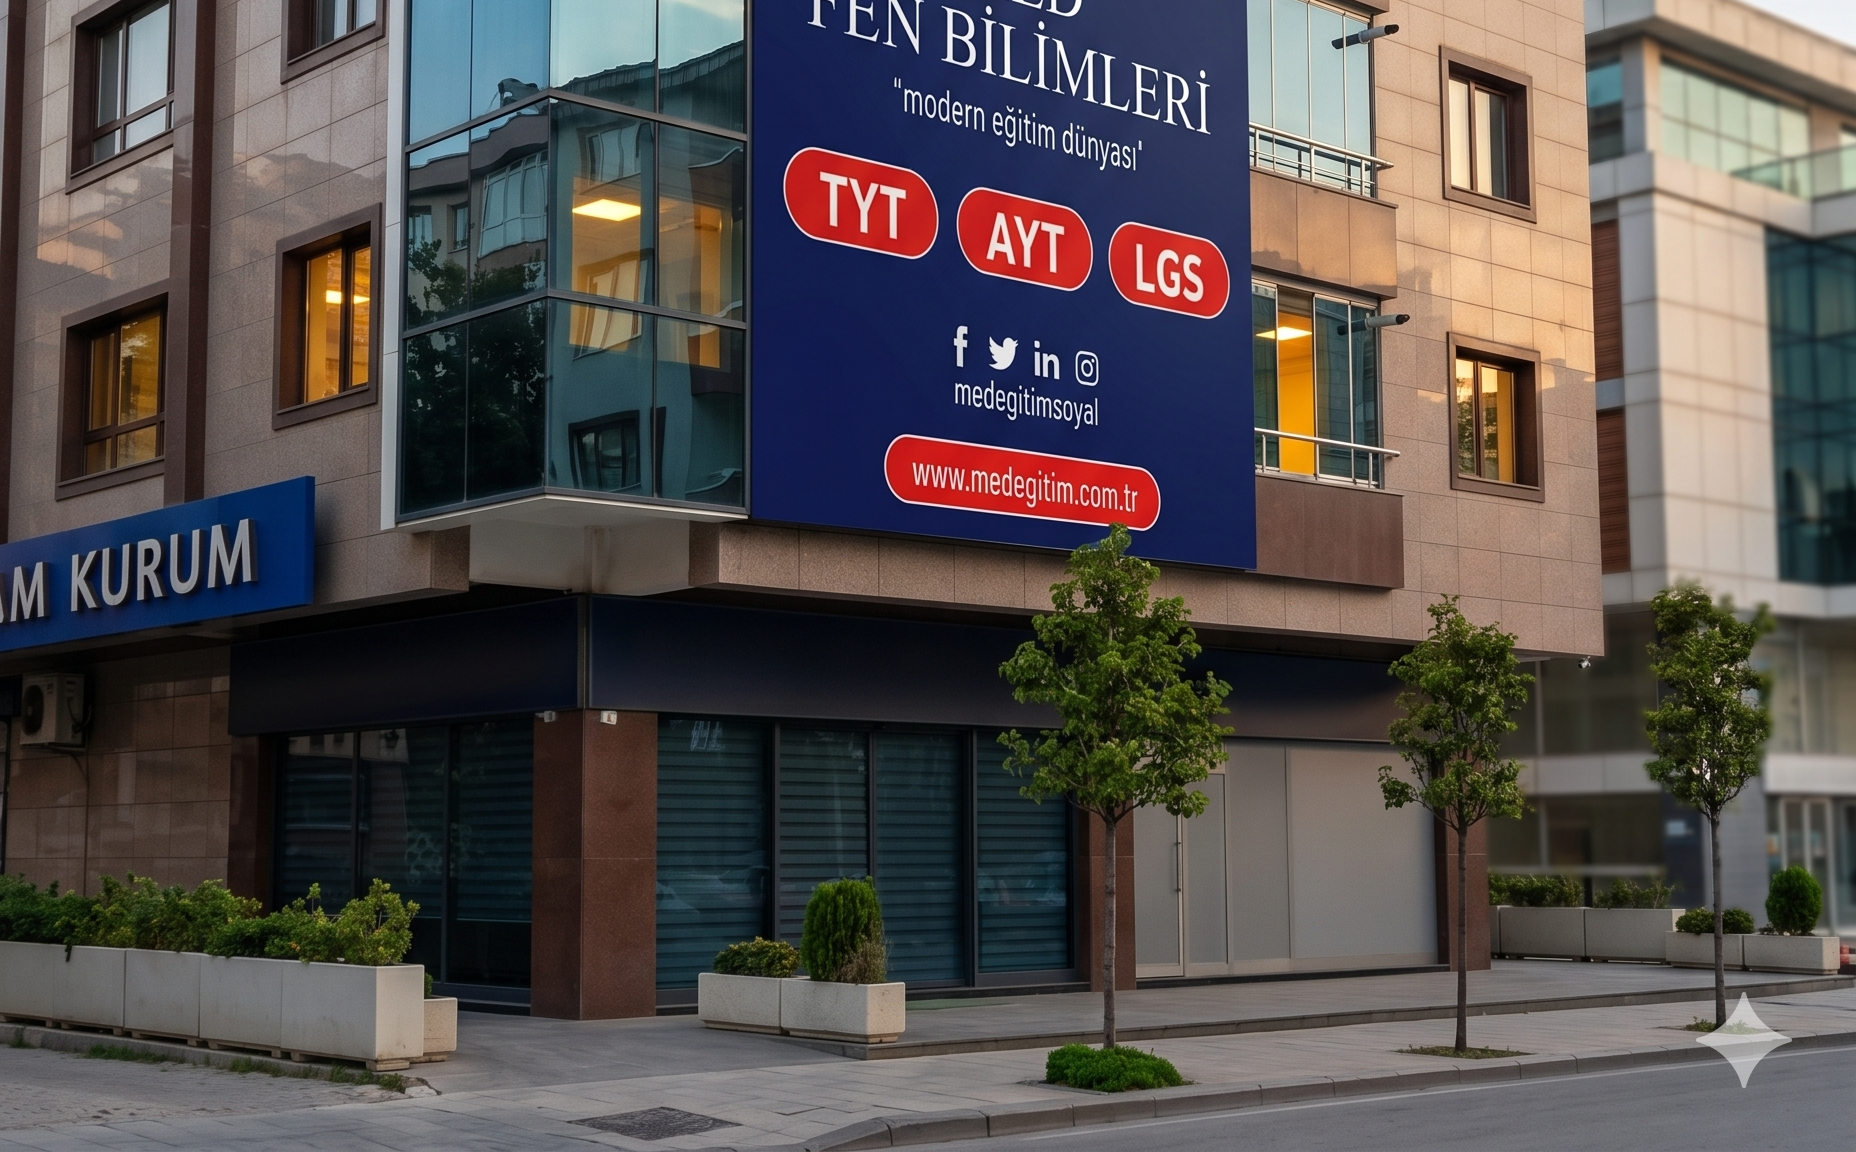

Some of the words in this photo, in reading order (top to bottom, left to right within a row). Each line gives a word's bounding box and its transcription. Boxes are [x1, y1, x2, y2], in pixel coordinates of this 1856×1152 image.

[941, 5, 1211, 135] BİLİMLERİ
[992, 105, 1056, 151] eğitim
[819, 171, 907, 239] TYT
[986, 212, 1065, 273] AYT
[1136, 243, 1204, 302] LGS
[954, 379, 1099, 430] medegitimsoyal
[911, 460, 1138, 514] www.medegitim.com.tr
[0, 561, 46, 624] M
[70, 518, 254, 612] KURUM
